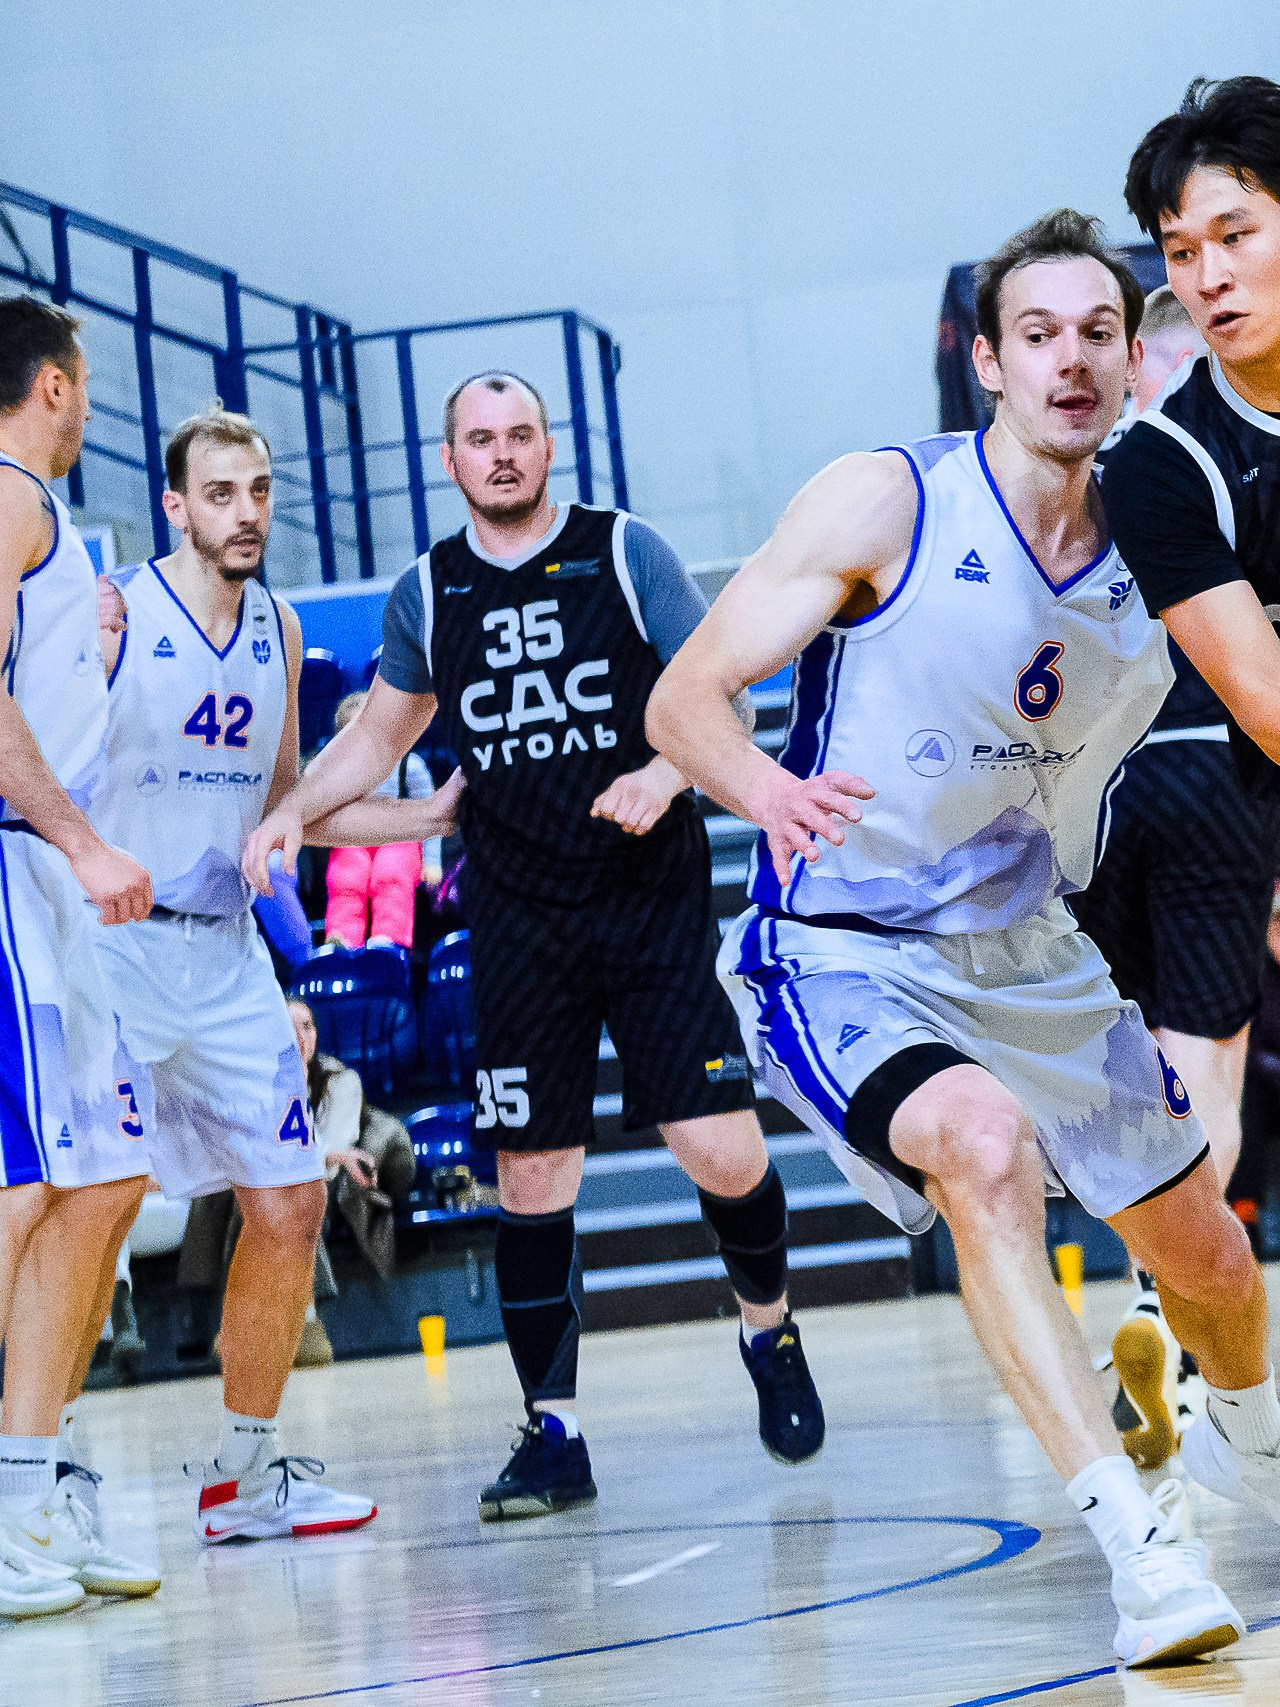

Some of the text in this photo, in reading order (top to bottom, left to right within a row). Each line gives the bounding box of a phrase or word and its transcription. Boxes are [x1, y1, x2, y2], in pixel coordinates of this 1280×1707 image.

[955, 567, 990, 584] PEAK
[482, 599, 564, 669] 35
[460, 658, 613, 732] СДС
[1013, 640, 1065, 722] 6
[180, 690, 255, 750] 42
[472, 723, 618, 772] УГОЛЬ
[475, 1066, 530, 1129] 35
[1153, 1044, 1193, 1120] 6
